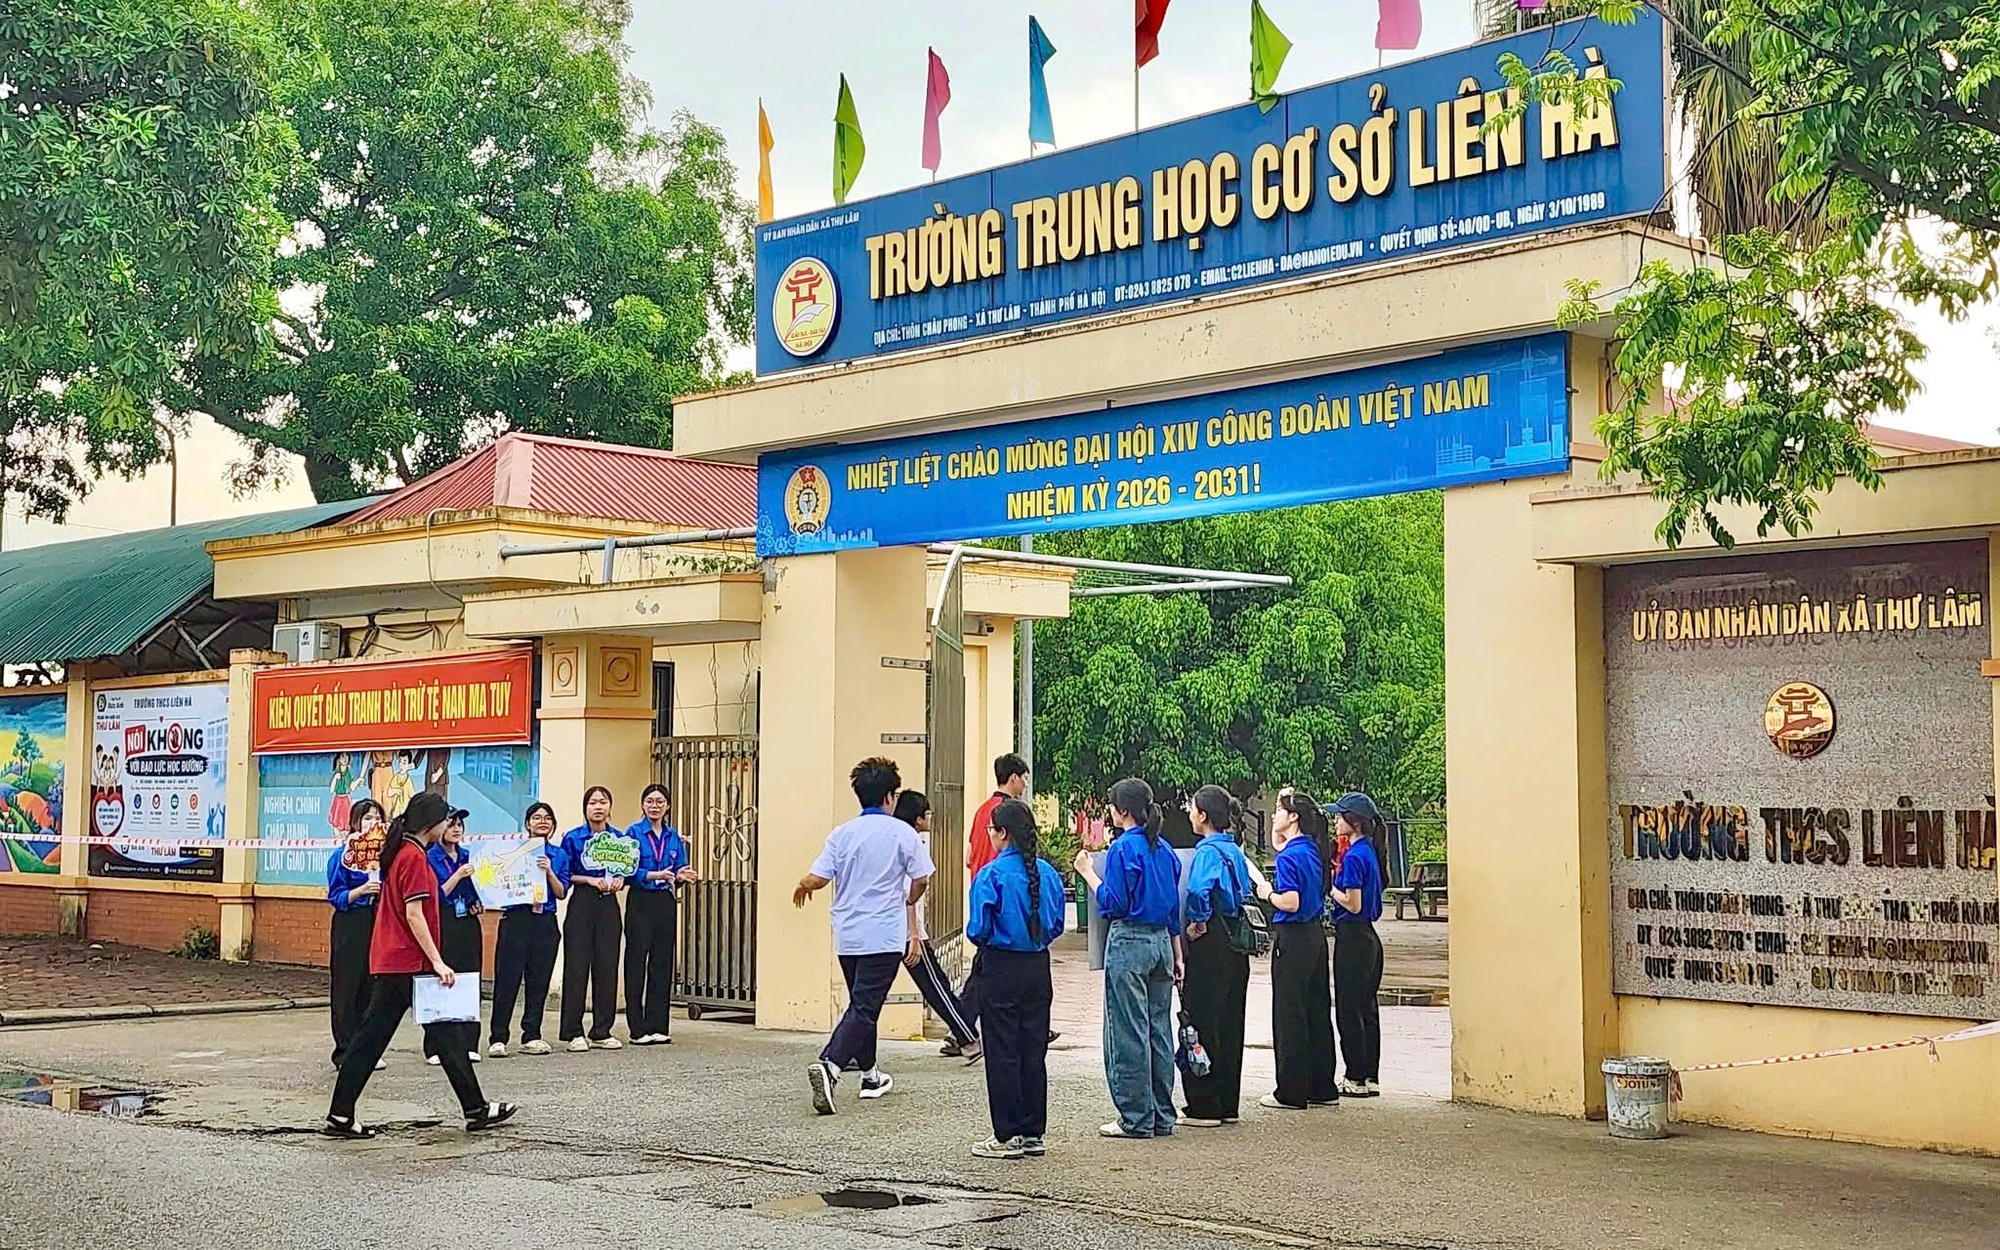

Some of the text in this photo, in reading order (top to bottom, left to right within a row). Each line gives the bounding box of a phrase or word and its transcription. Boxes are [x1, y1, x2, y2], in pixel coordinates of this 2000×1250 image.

[865, 46, 1618, 300] TRƯỜNG TRUNG HỌC CƠ SỞ LIÊN HÀ
[772, 229, 786, 240] BAN
[787, 223, 805, 237] NHÂN
[806, 219, 820, 233] DÂN
[845, 211, 859, 224] LÂM
[922, 317, 942, 337] CHÂU
[943, 315, 968, 332] PHONG
[987, 308, 1004, 324] THƯ
[1003, 304, 1021, 321] LÂM
[1030, 295, 1056, 318] THÀNH
[1058, 290, 1075, 312] PHỐ
[1077, 290, 1089, 309] HÀ
[1091, 286, 1106, 311] NỘI
[1174, 274, 1191, 291] 078
[1380, 222, 1411, 253] QUYẾT
[1414, 230, 1438, 249] ĐỊNH
[1517, 199, 1546, 225] NGÀY
[847, 373, 1490, 493] NHIỆT LIỆT CHÀO MỪNG ĐẠI HỘI XIV CÔNG ĐOÀN VIỆT NAM
[1007, 482, 1075, 523] NHIỆM
[1081, 475, 1110, 512] KỲ
[1116, 475, 1171, 509] 2026
[1194, 463, 1261, 500] 2031!
[1632, 600, 1660, 641] UỶ
[1664, 607, 1710, 641] BAN
[1714, 598, 1779, 639] NHÂN
[1782, 595, 1831, 634] DÂN
[1836, 592, 1870, 634] XÃ
[1873, 593, 1923, 631] THƯ
[1928, 587, 1983, 628] LÂM
[156, 697, 170, 708] THCS
[170, 695, 184, 708] LIÊN
[184, 694, 192, 707] HÀ
[268, 673, 512, 732] KIÊN QUYẾT ĐẤU TRANH BÀI TRỪ TỆ NẠN MA TUÝ
[127, 729, 144, 753] NÓI
[166, 760, 180, 775] HỌC
[1618, 790, 1750, 863] TRƯỜNG
[1759, 806, 1851, 866] THCS
[1861, 795, 1945, 869] LIÊN
